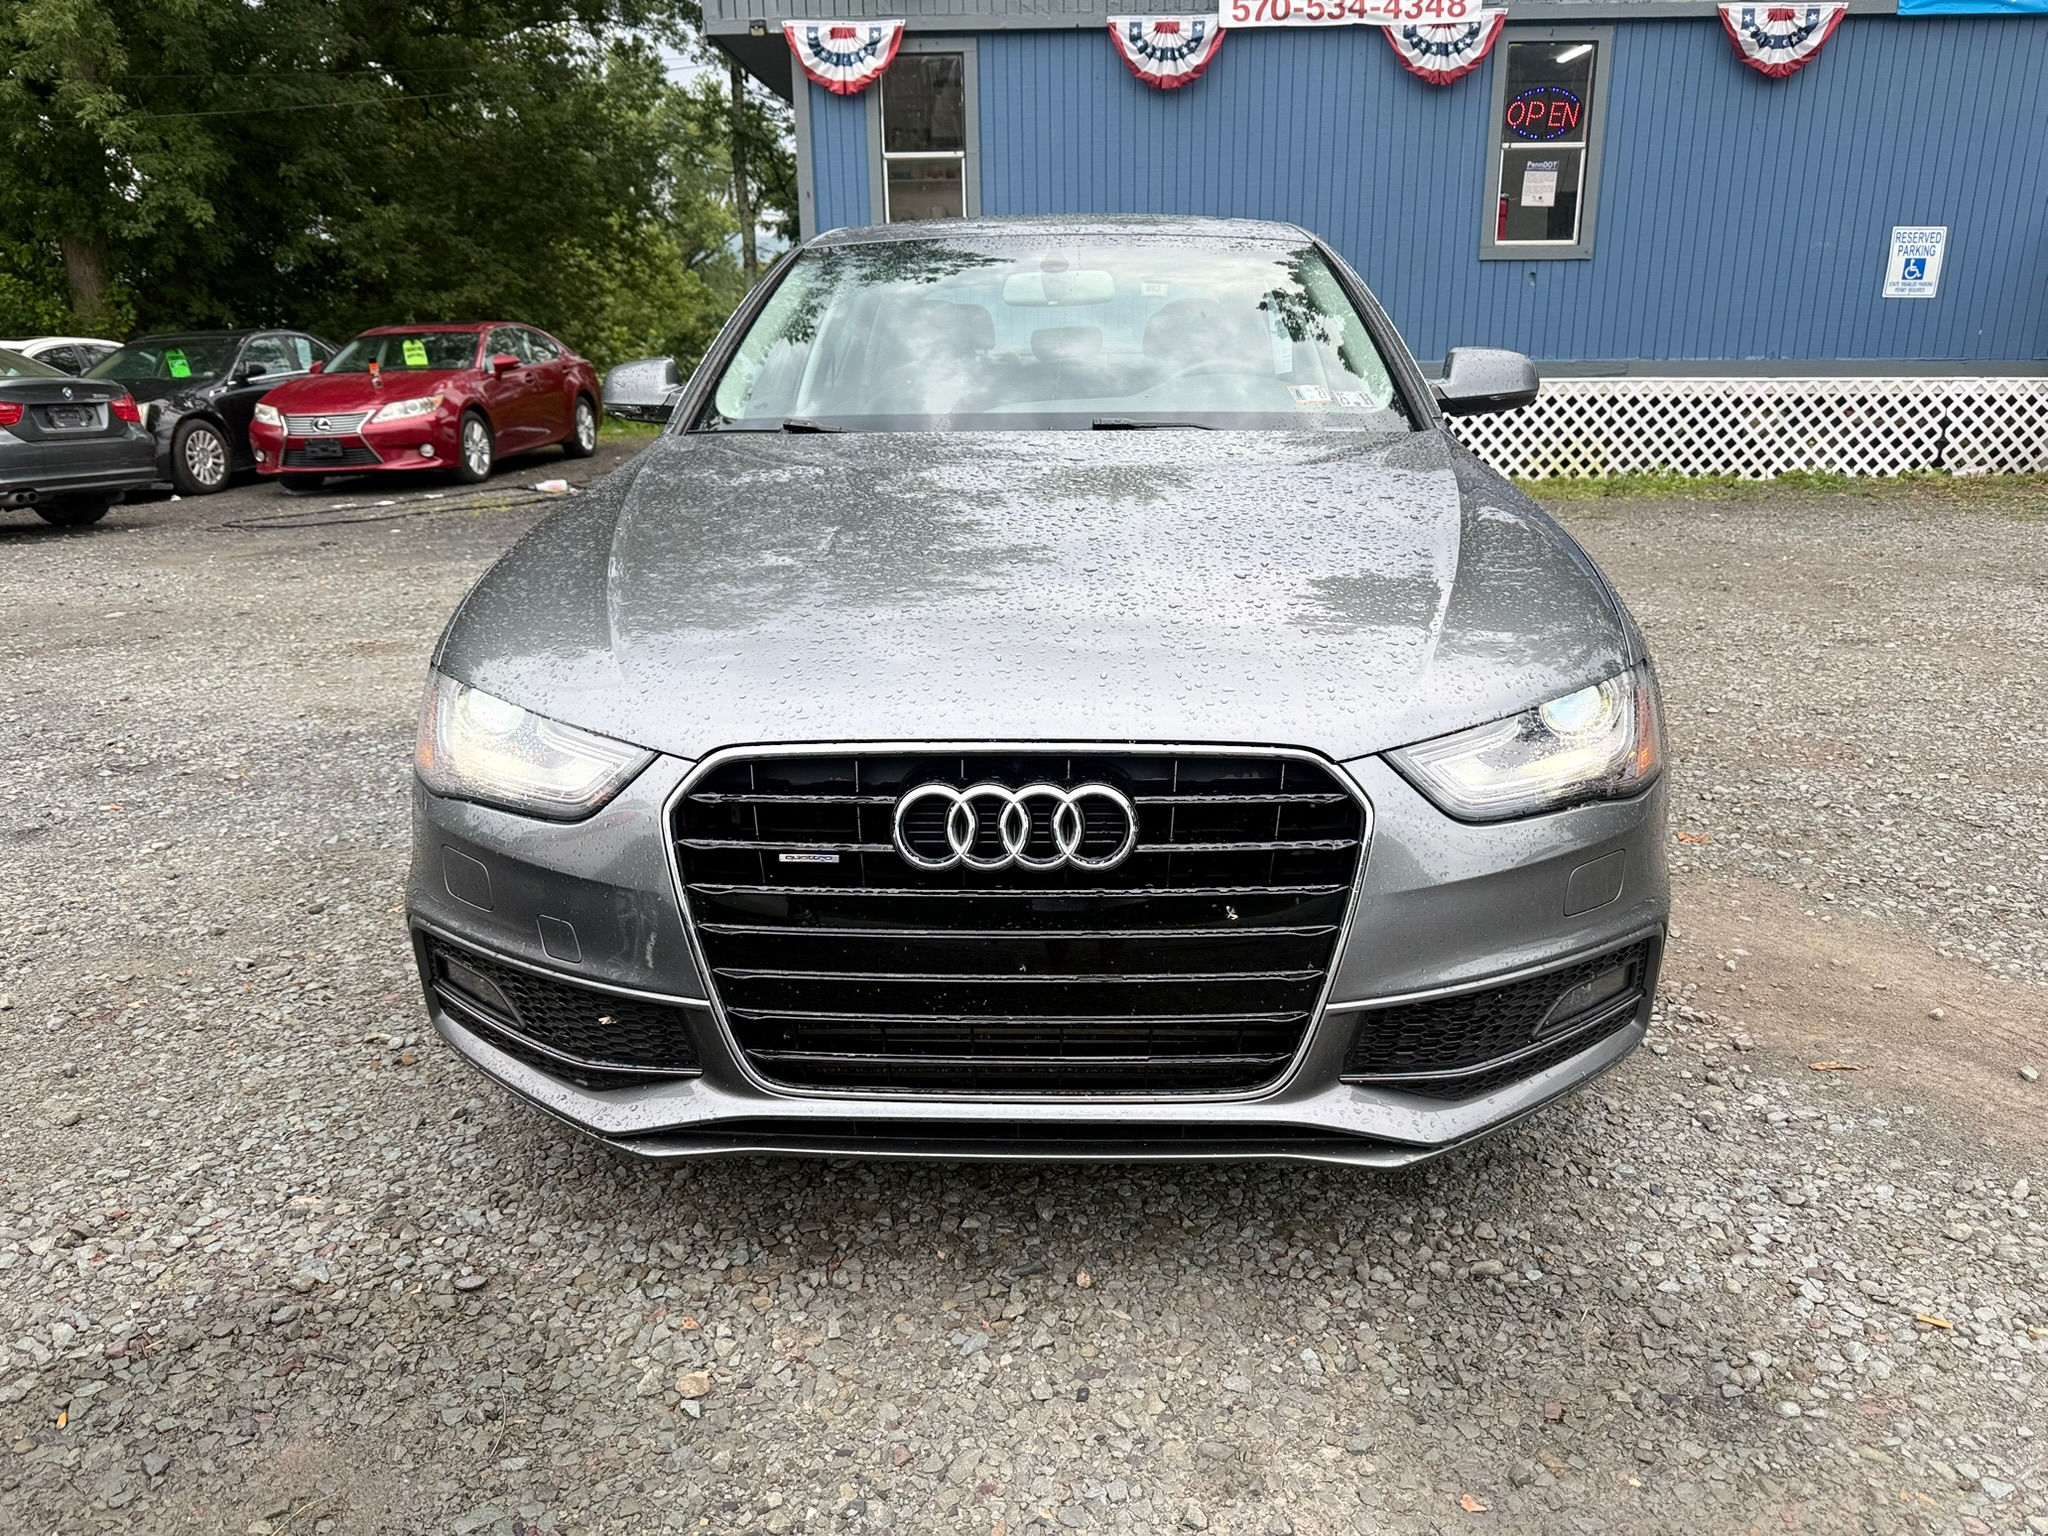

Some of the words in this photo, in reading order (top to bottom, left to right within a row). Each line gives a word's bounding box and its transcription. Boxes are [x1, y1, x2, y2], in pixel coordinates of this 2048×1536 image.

[1231, 0, 1468, 22] 570-534-4348
[1507, 100, 1580, 127] OPEN
[1527, 160, 1558, 168] PennDOT
[1895, 231, 1942, 243] RESERVED
[1897, 245, 1936, 256] PARKING
